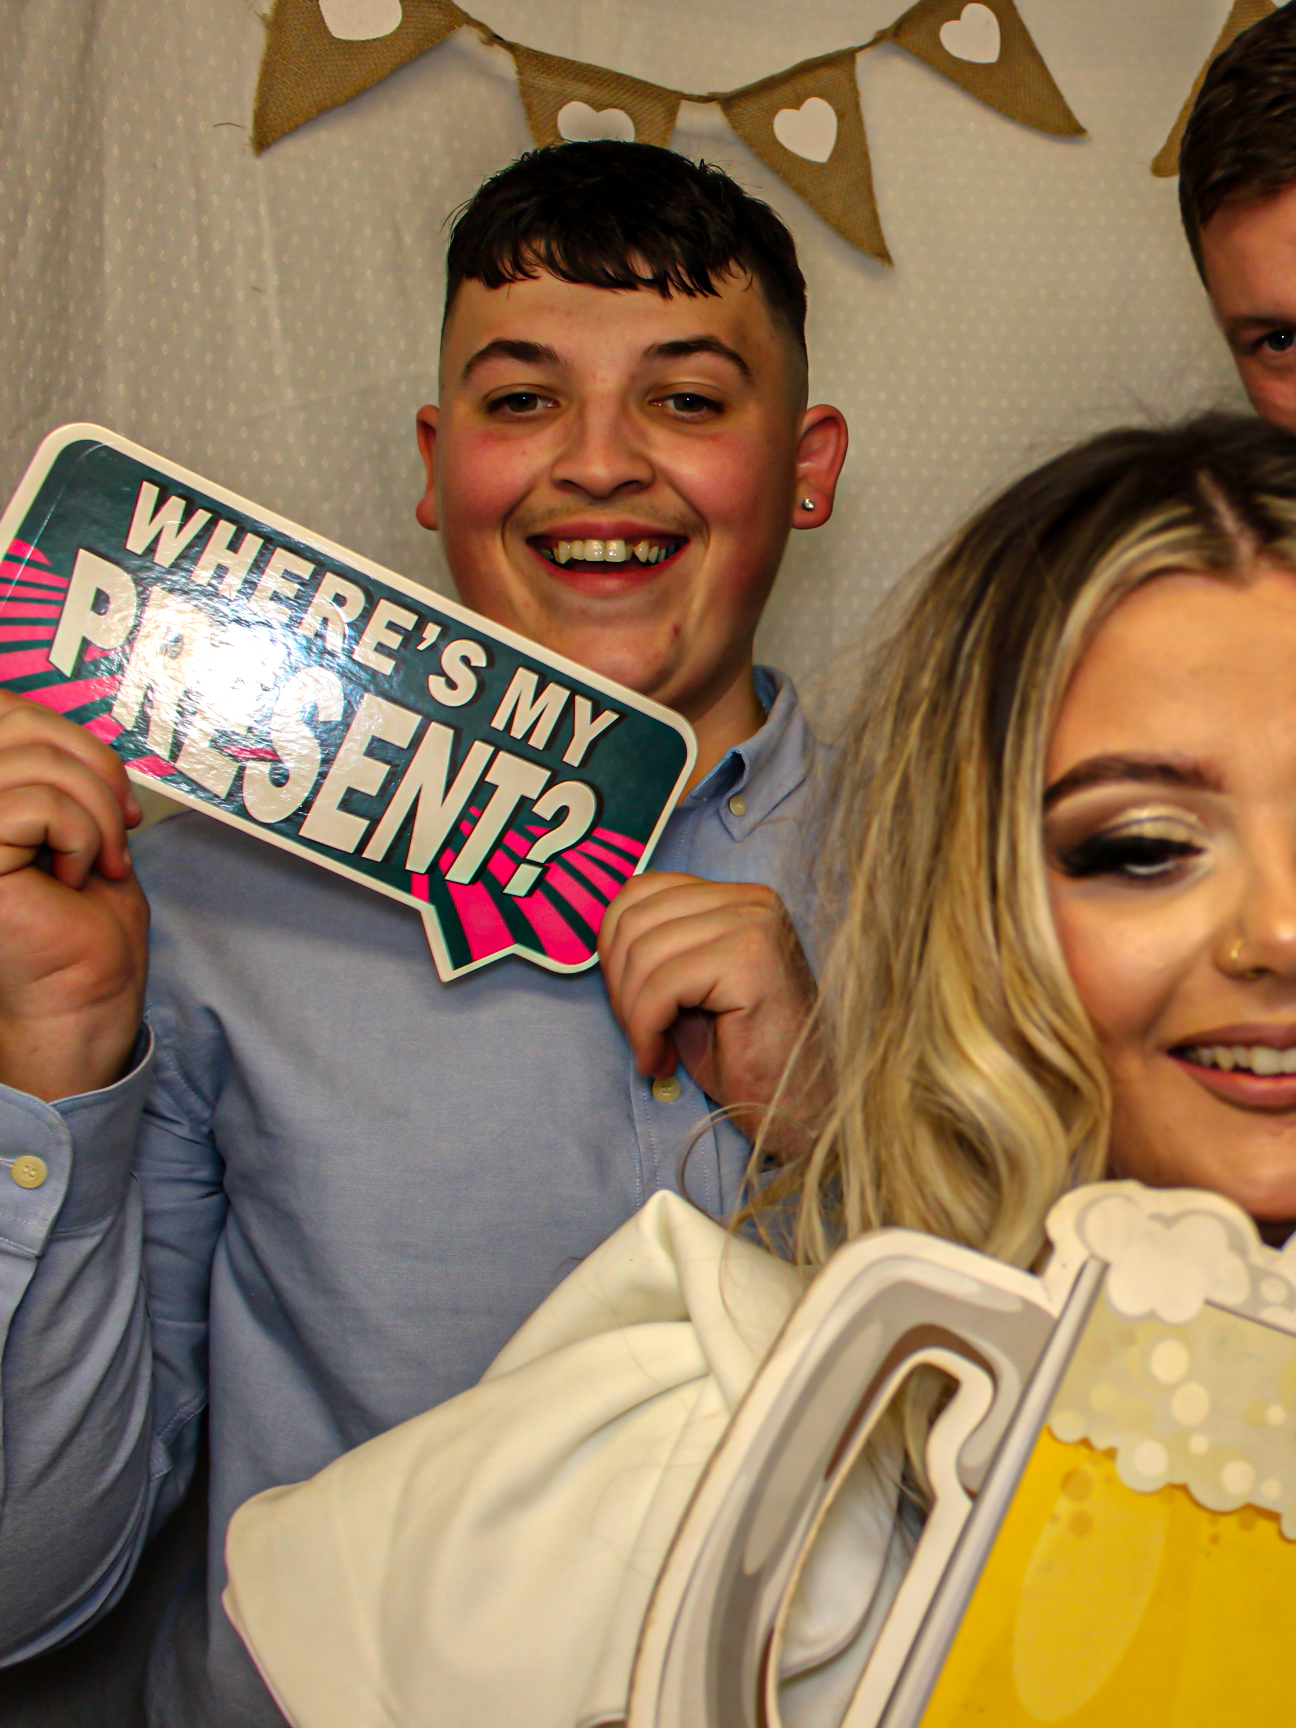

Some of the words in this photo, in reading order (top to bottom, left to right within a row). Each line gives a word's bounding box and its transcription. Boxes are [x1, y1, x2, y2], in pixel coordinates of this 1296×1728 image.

[49, 548, 597, 898] PRESENT?
[125, 481, 488, 708] WHERE'S
[491, 667, 619, 768] MY
